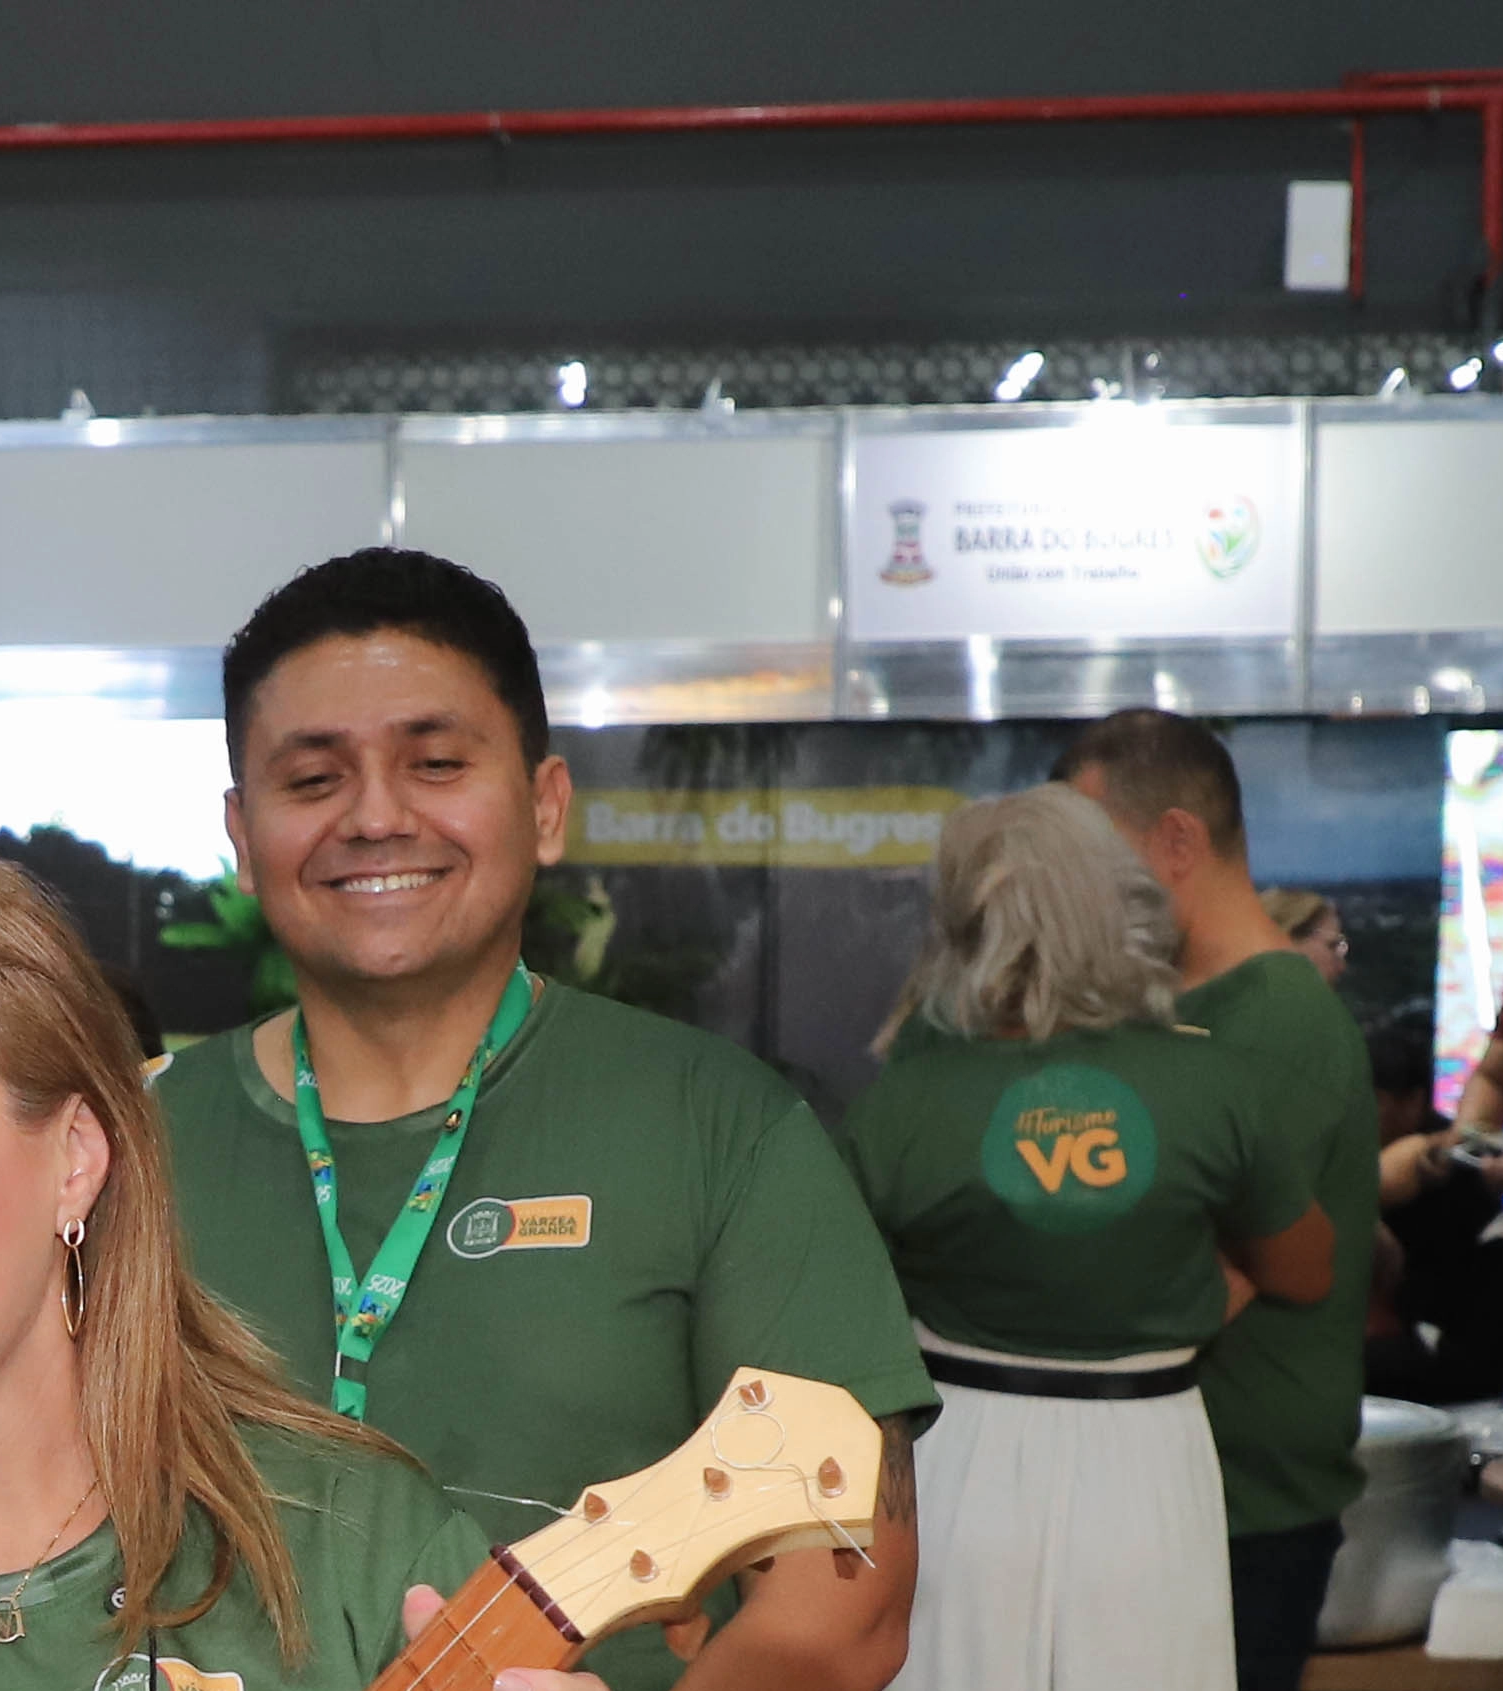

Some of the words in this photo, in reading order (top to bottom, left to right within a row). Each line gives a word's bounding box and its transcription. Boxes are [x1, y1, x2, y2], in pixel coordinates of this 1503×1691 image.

[955, 526, 1034, 552] BARRA
[586, 802, 704, 843] Barra
[717, 801, 776, 842] do
[782, 801, 944, 857] Bugres
[1015, 1128, 1127, 1194] VG
[366, 1274, 407, 1299] 2025
